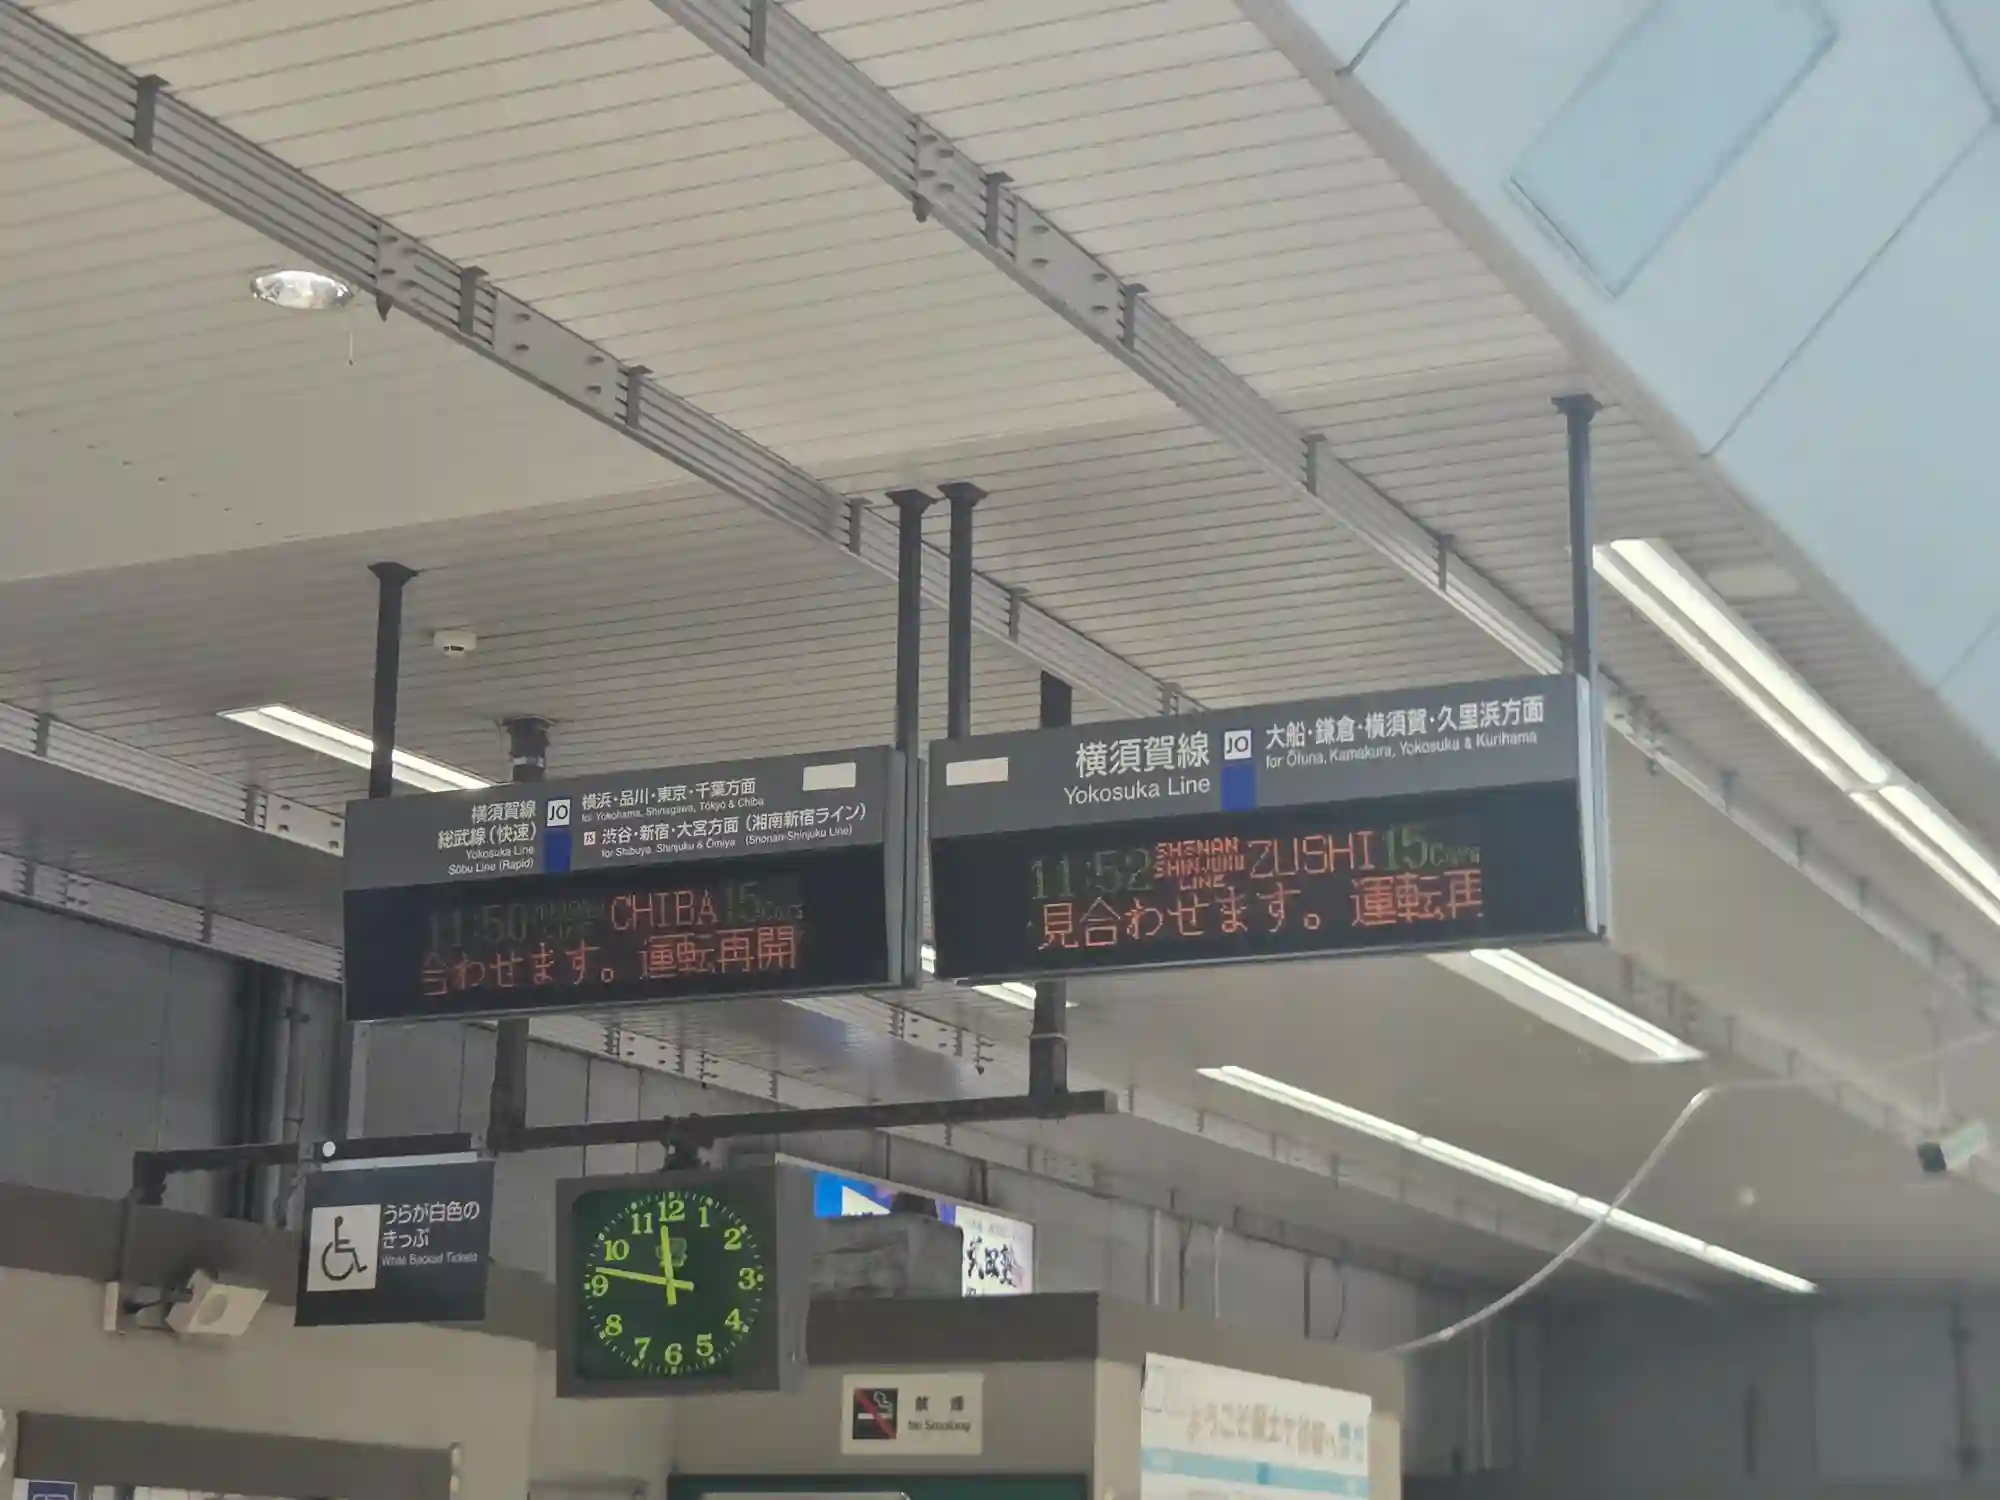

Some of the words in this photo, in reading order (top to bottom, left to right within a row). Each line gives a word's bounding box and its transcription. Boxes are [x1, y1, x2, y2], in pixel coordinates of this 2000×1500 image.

[1076, 730, 1210, 778] 横須賀線
[1227, 736, 1249, 754] JO
[1266, 755, 1283, 770] for
[1400, 737, 1460, 757] Yokosuka
[1464, 736, 1472, 749] &
[1476, 731, 1538, 748] Kurihama
[738, 796, 765, 808] Chiba
[1064, 780, 1160, 805] Yokosuka
[1168, 776, 1211, 796] Line
[471, 800, 536, 825] 横須賀線
[549, 804, 568, 821] JO
[466, 848, 512, 861] Yokosuka
[514, 845, 534, 856] Line
[1248, 830, 1376, 878] ZUSHI
[476, 861, 496, 873] Line
[1031, 848, 1153, 900] 11:52
[611, 888, 718, 931] CHIBA
[429, 902, 527, 949] 11:50
[384, 1200, 480, 1225] うらが白色の
[658, 1200, 685, 1222] 12
[699, 1204, 710, 1228] 1
[631, 1212, 653, 1235] 11
[604, 1238, 630, 1262] 10
[723, 1227, 742, 1251] 2
[591, 1274, 609, 1297] 9
[738, 1267, 757, 1290] 3
[604, 1313, 623, 1336] 8
[724, 1308, 744, 1331] 4
[634, 1336, 651, 1360] 7
[665, 1342, 683, 1366] 6
[696, 1332, 714, 1357] 5
